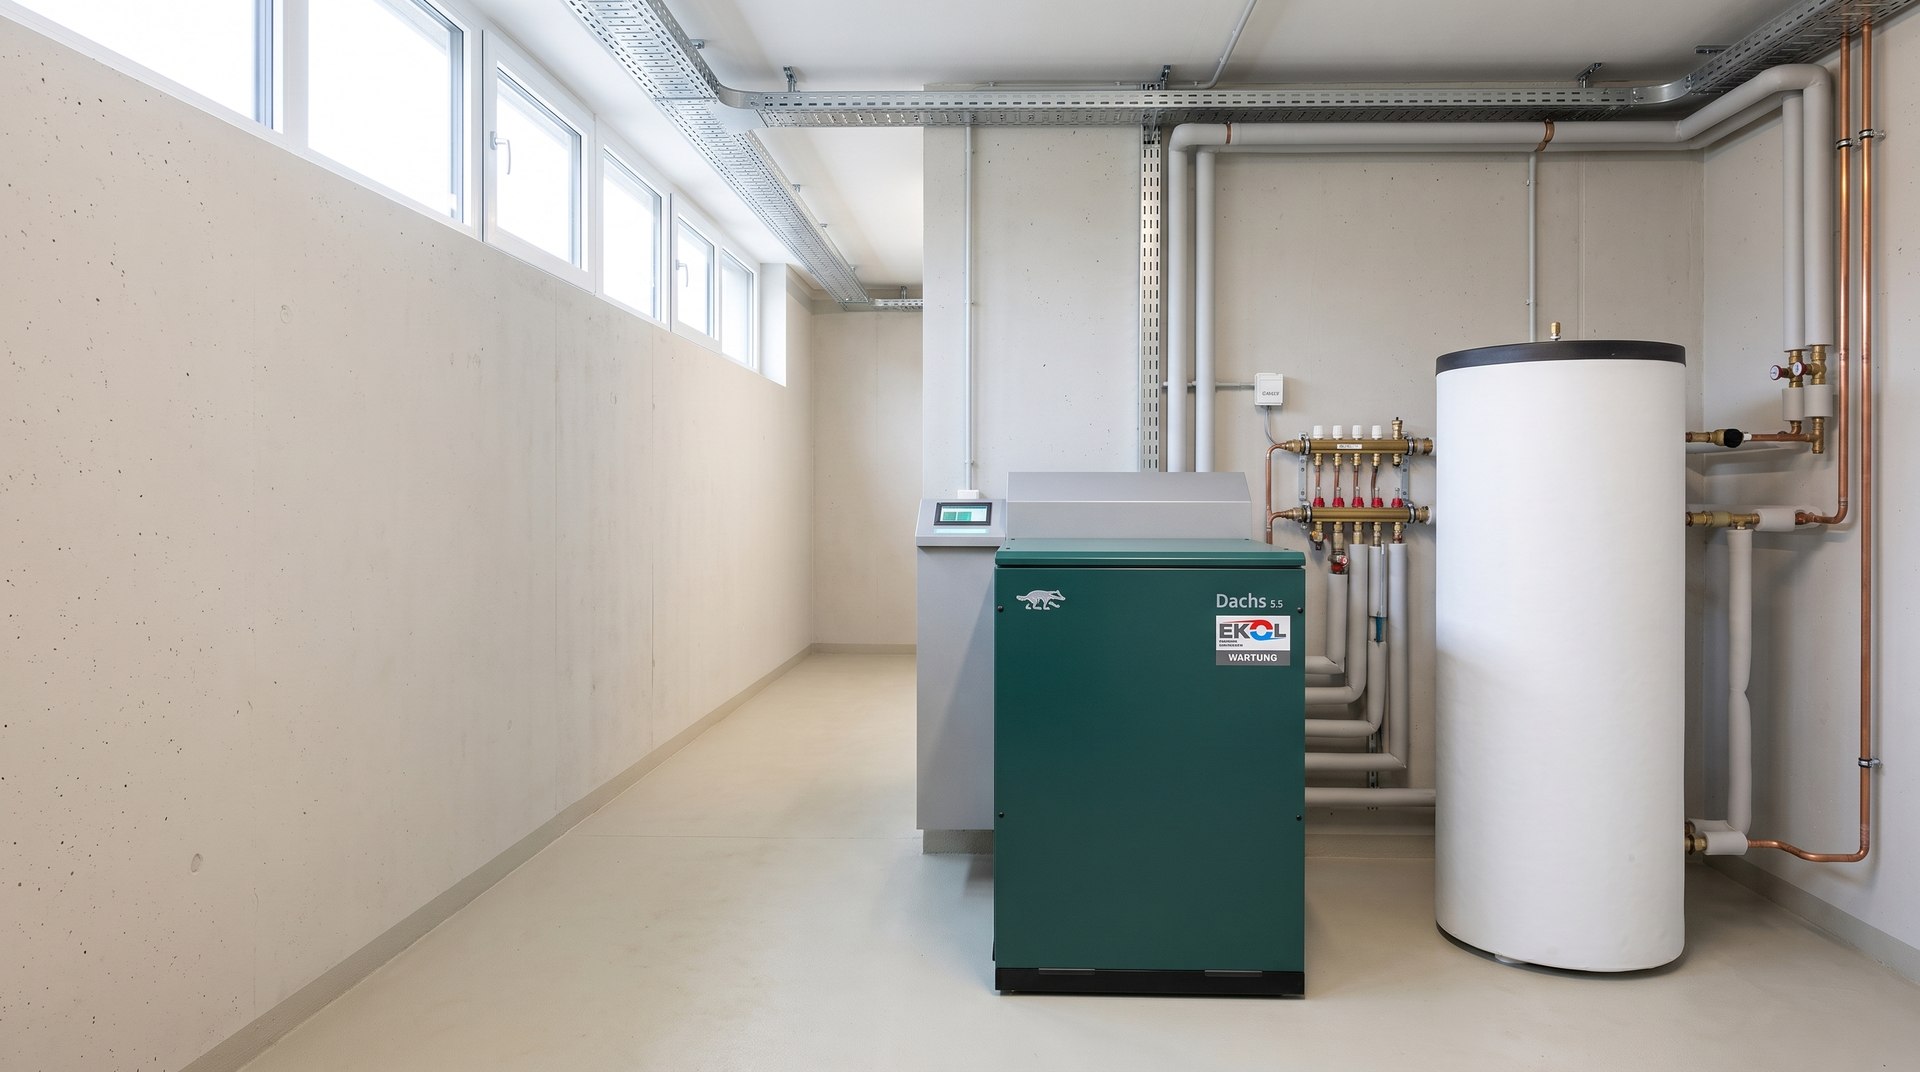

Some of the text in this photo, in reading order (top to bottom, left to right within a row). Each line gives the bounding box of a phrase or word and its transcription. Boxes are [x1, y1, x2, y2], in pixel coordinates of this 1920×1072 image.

[1216, 592, 1284, 609] Dachs 5.5
[1218, 619, 1287, 642] EKOL
[1228, 653, 1278, 662] WARTUNG
